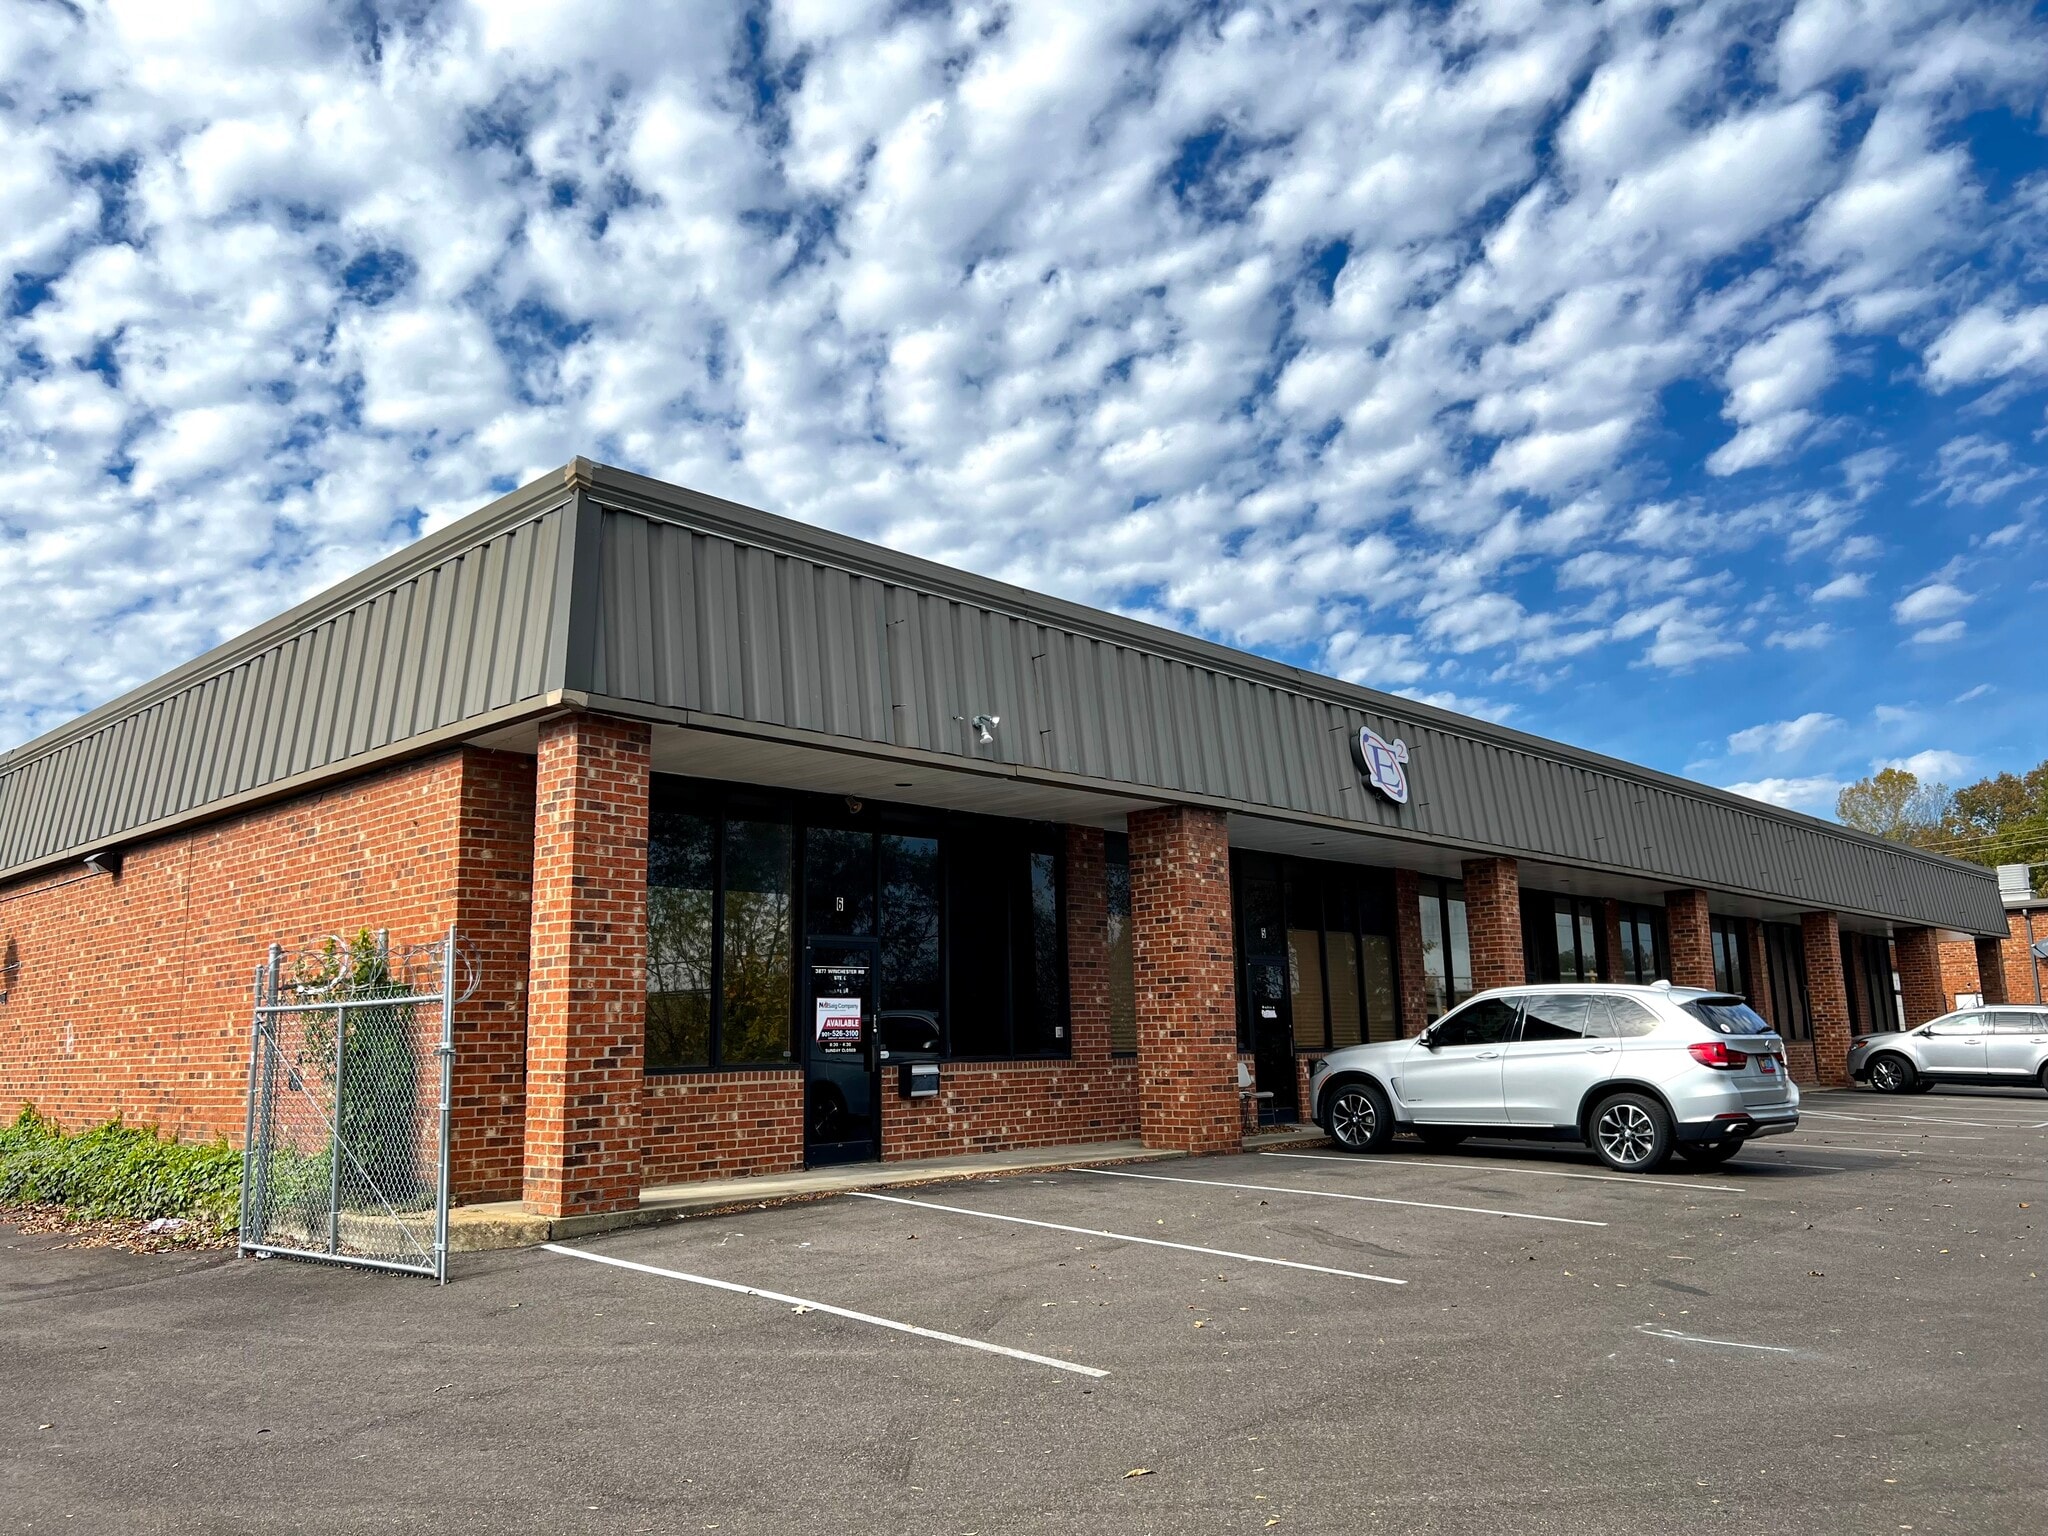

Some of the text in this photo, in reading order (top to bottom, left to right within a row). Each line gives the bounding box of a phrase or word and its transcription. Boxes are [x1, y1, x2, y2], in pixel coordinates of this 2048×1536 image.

[836, 897, 844, 912] 6
[826, 1019, 859, 1027] AVAILABLE
[821, 1029, 859, 1037] 901-526-3100
